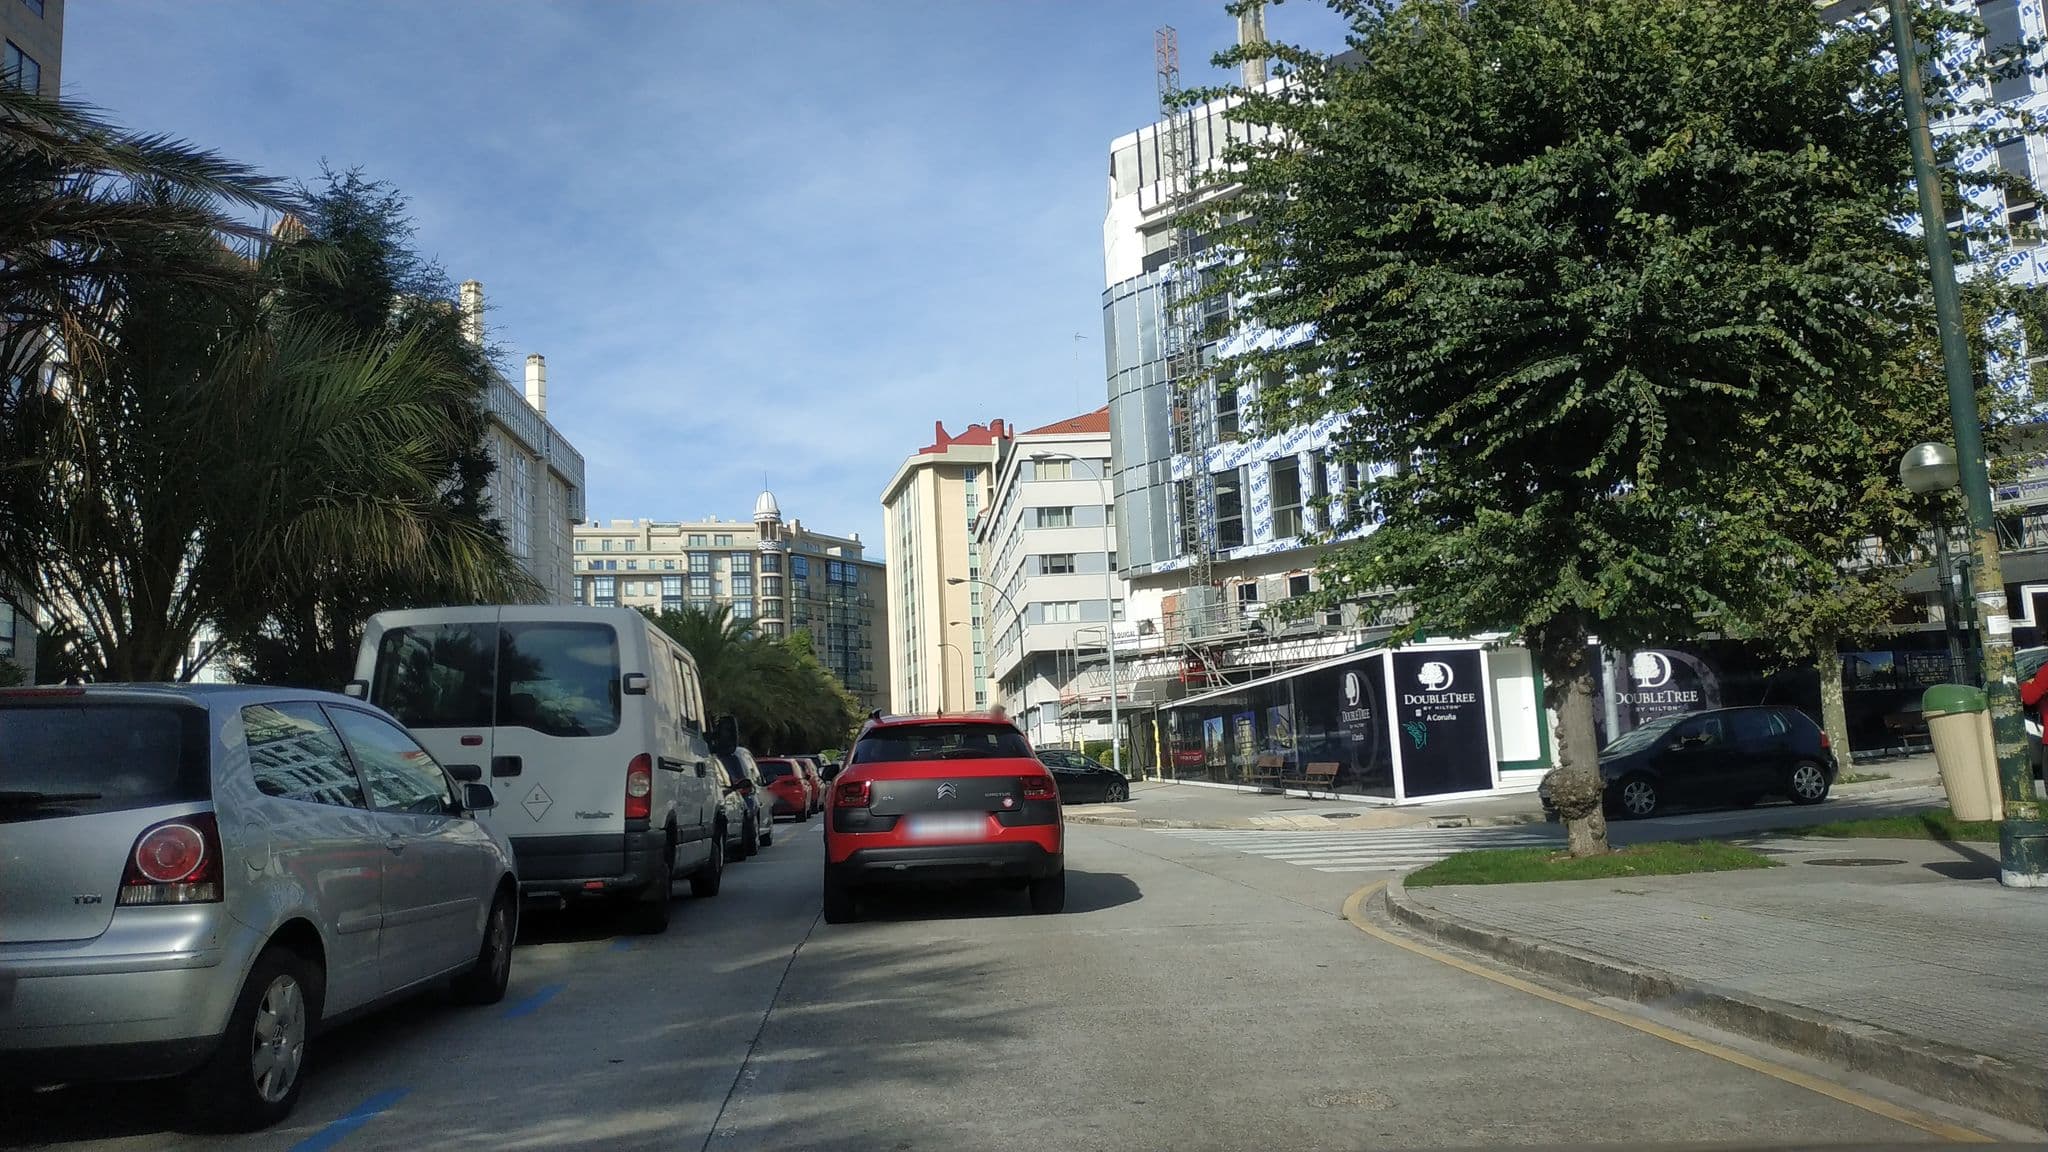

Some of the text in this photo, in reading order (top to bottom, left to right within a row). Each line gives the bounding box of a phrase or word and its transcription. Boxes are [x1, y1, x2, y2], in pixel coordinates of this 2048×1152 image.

[1959, 143, 1996, 172] rson
[1994, 250, 2030, 277] rson
[1217, 334, 1239, 353] larso
[1246, 326, 1267, 348] larso
[1312, 414, 1341, 439] larson
[1252, 434, 1268, 451] lars
[1282, 428, 1309, 452] larson
[1172, 456, 1192, 474] larso
[1225, 446, 1251, 469] larson
